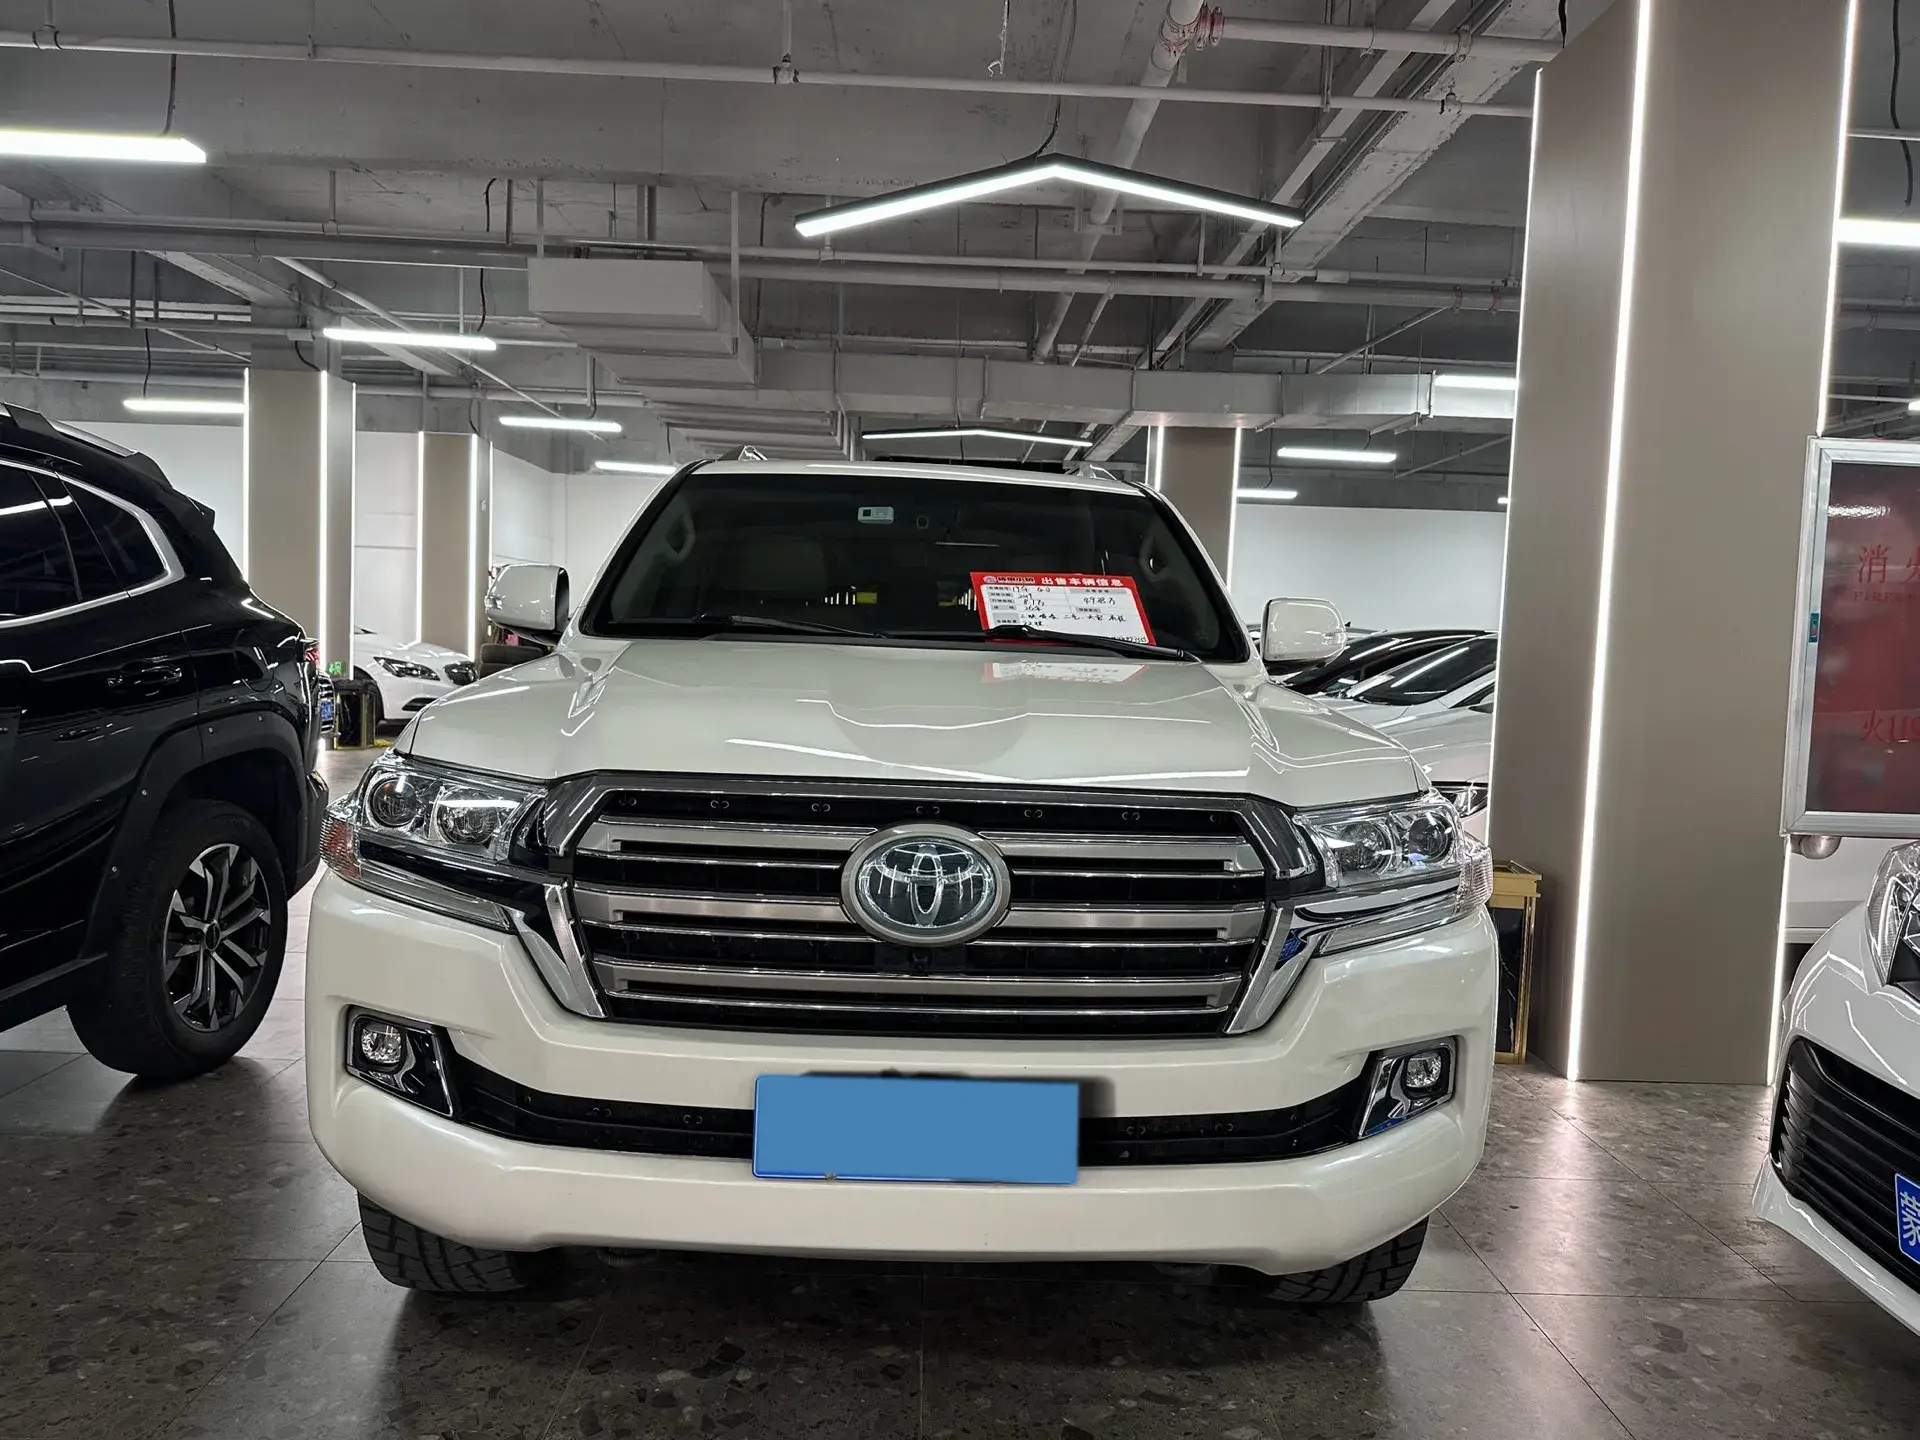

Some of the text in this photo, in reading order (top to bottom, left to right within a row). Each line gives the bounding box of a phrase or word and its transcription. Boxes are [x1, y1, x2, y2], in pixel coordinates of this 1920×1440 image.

[1041, 576, 1124, 587] 出售车辆信息
